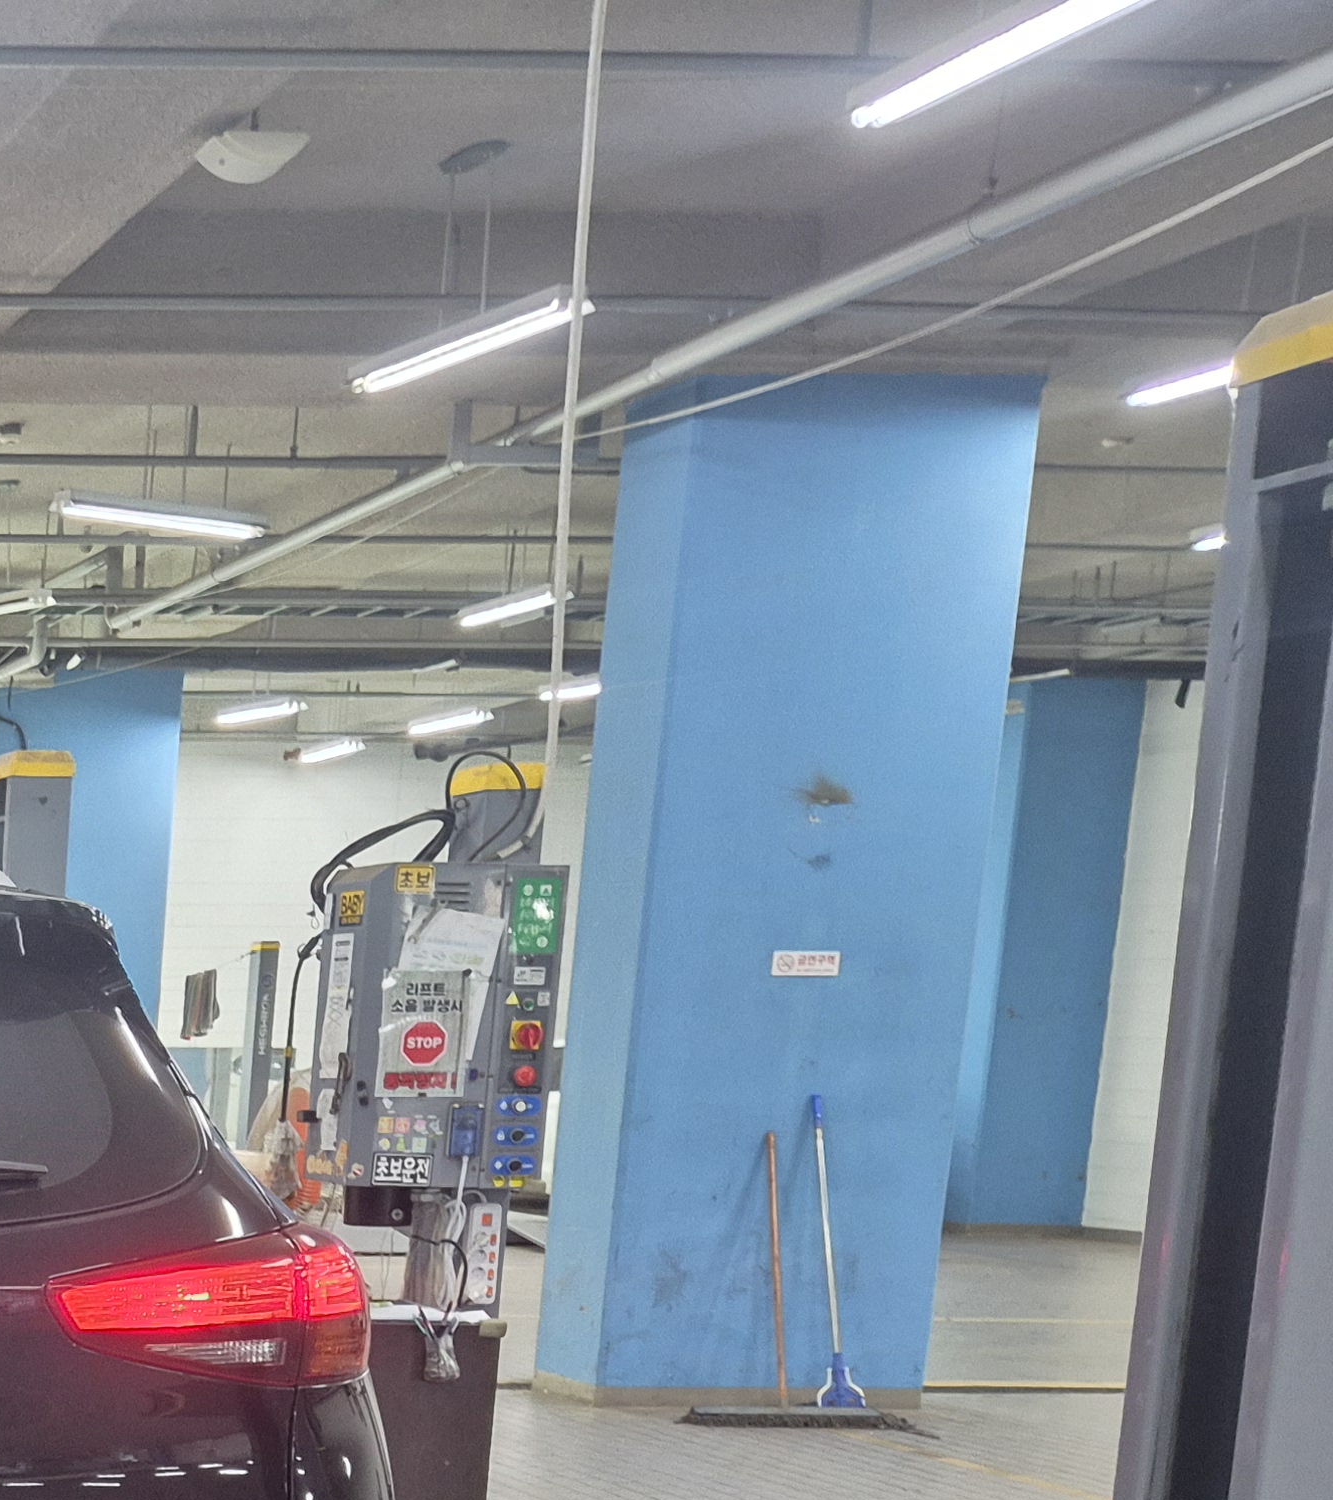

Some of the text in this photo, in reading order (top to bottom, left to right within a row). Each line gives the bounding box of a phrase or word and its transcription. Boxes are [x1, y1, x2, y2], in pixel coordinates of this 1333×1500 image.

[399, 870, 431, 889] 초보
[406, 982, 446, 997] 리프트
[391, 999, 462, 1013] 소음 발생시
[406, 1037, 443, 1049] STOP
[374, 1156, 431, 1184] 초보운전
